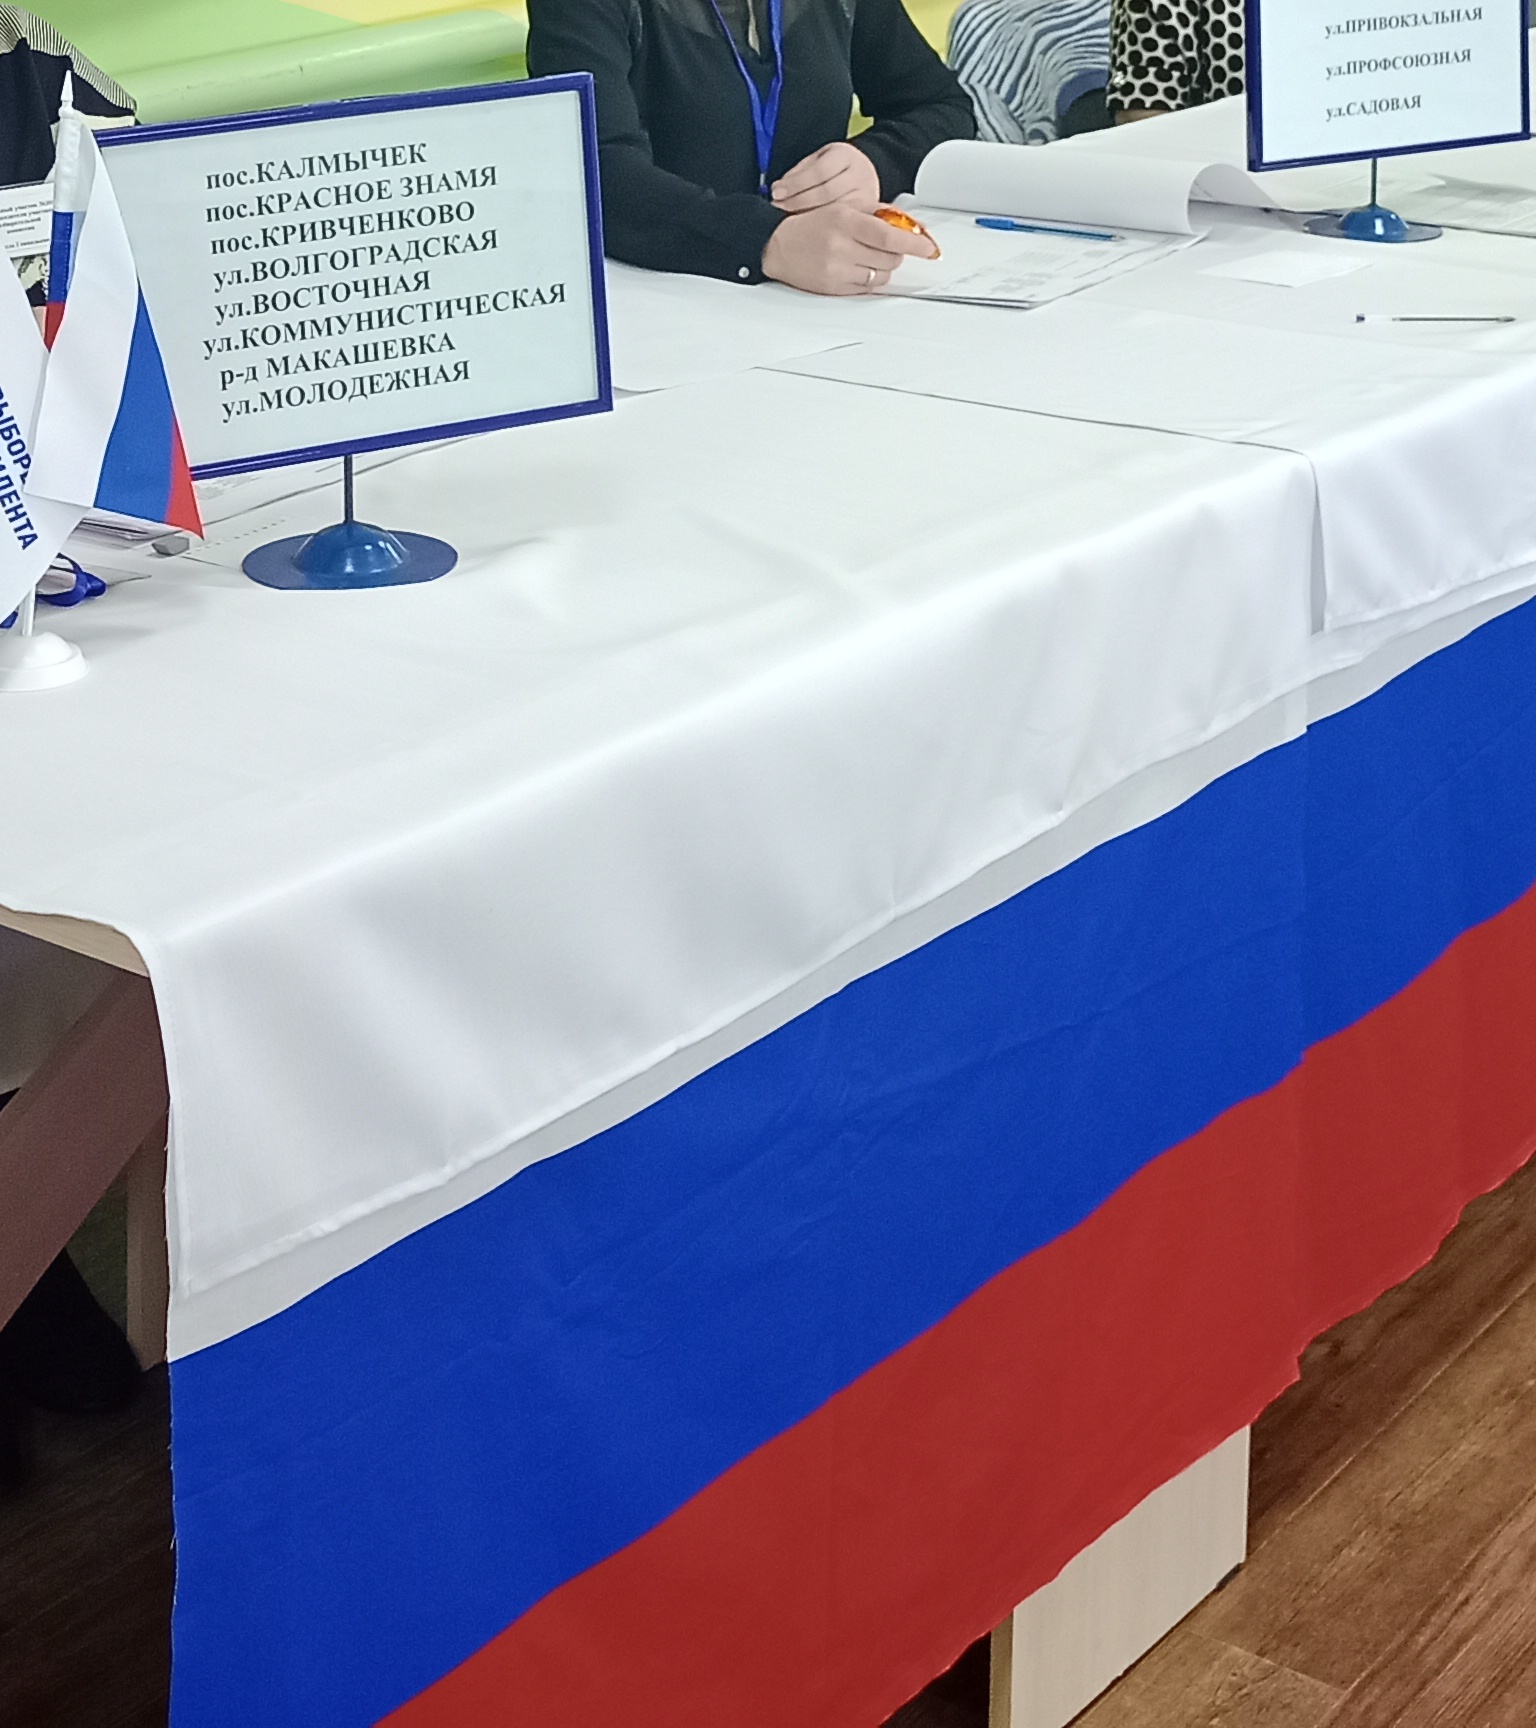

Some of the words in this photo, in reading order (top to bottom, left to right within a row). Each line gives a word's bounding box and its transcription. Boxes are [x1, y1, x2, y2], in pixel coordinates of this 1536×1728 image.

[1324, 7, 1483, 39] ул.ПРИВОКЗАЛЬНАЯ
[1325, 48, 1472, 80] ул.ПРОФСОЮЗНАЯ
[1325, 95, 1422, 122] ул.САДОВАЯ
[205, 142, 428, 191] пос.КАЛМЫЧЕК
[205, 179, 394, 224] пос.КРАСНОЕ
[399, 165, 498, 201] ЗНАМЯ
[210, 200, 476, 257] пос.КРИВЧЕНКОВО
[212, 229, 499, 292] ул.ВОЛГОГРАДСКАЯ
[202, 283, 567, 360] ул.КОММУНИСТИЧЕСКАЯ
[214, 270, 432, 326] ул.ВОСТОЧНАЯ
[219, 360, 261, 391] р-д
[266, 332, 457, 382] МАКАШЕВКА
[221, 359, 471, 424] ул.МОЛОДЕЖНАЯ
